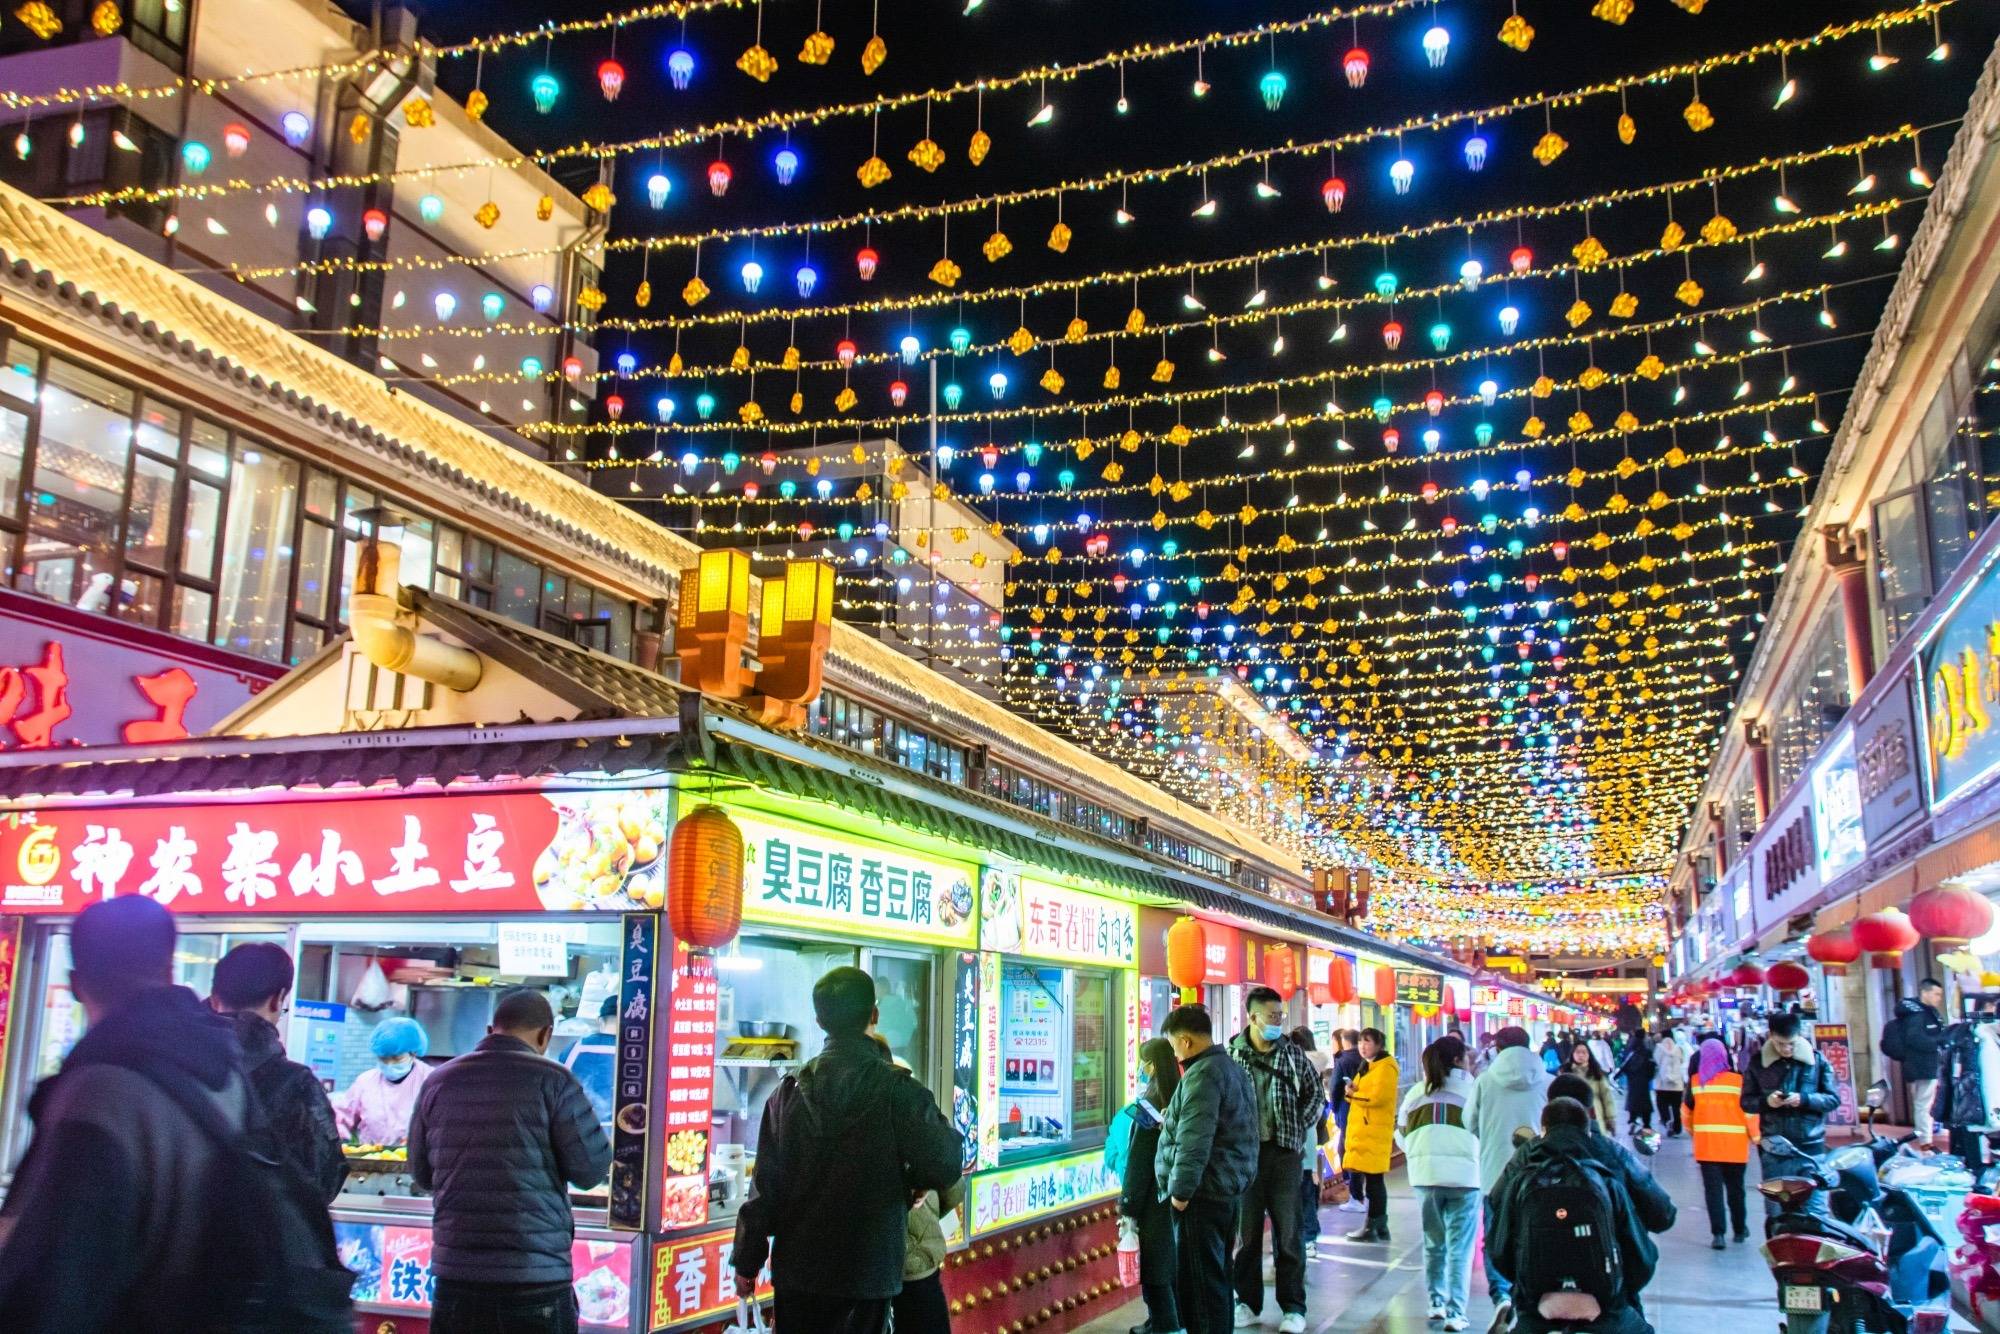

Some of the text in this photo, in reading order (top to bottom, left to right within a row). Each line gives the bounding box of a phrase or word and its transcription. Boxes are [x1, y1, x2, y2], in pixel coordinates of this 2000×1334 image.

[70, 813, 516, 907] 神农架小土豆
[763, 837, 932, 925] 臭豆腐香豆腐
[624, 924, 648, 1021] 臭豆腐
[1024, 1037, 1047, 1046] 12315
